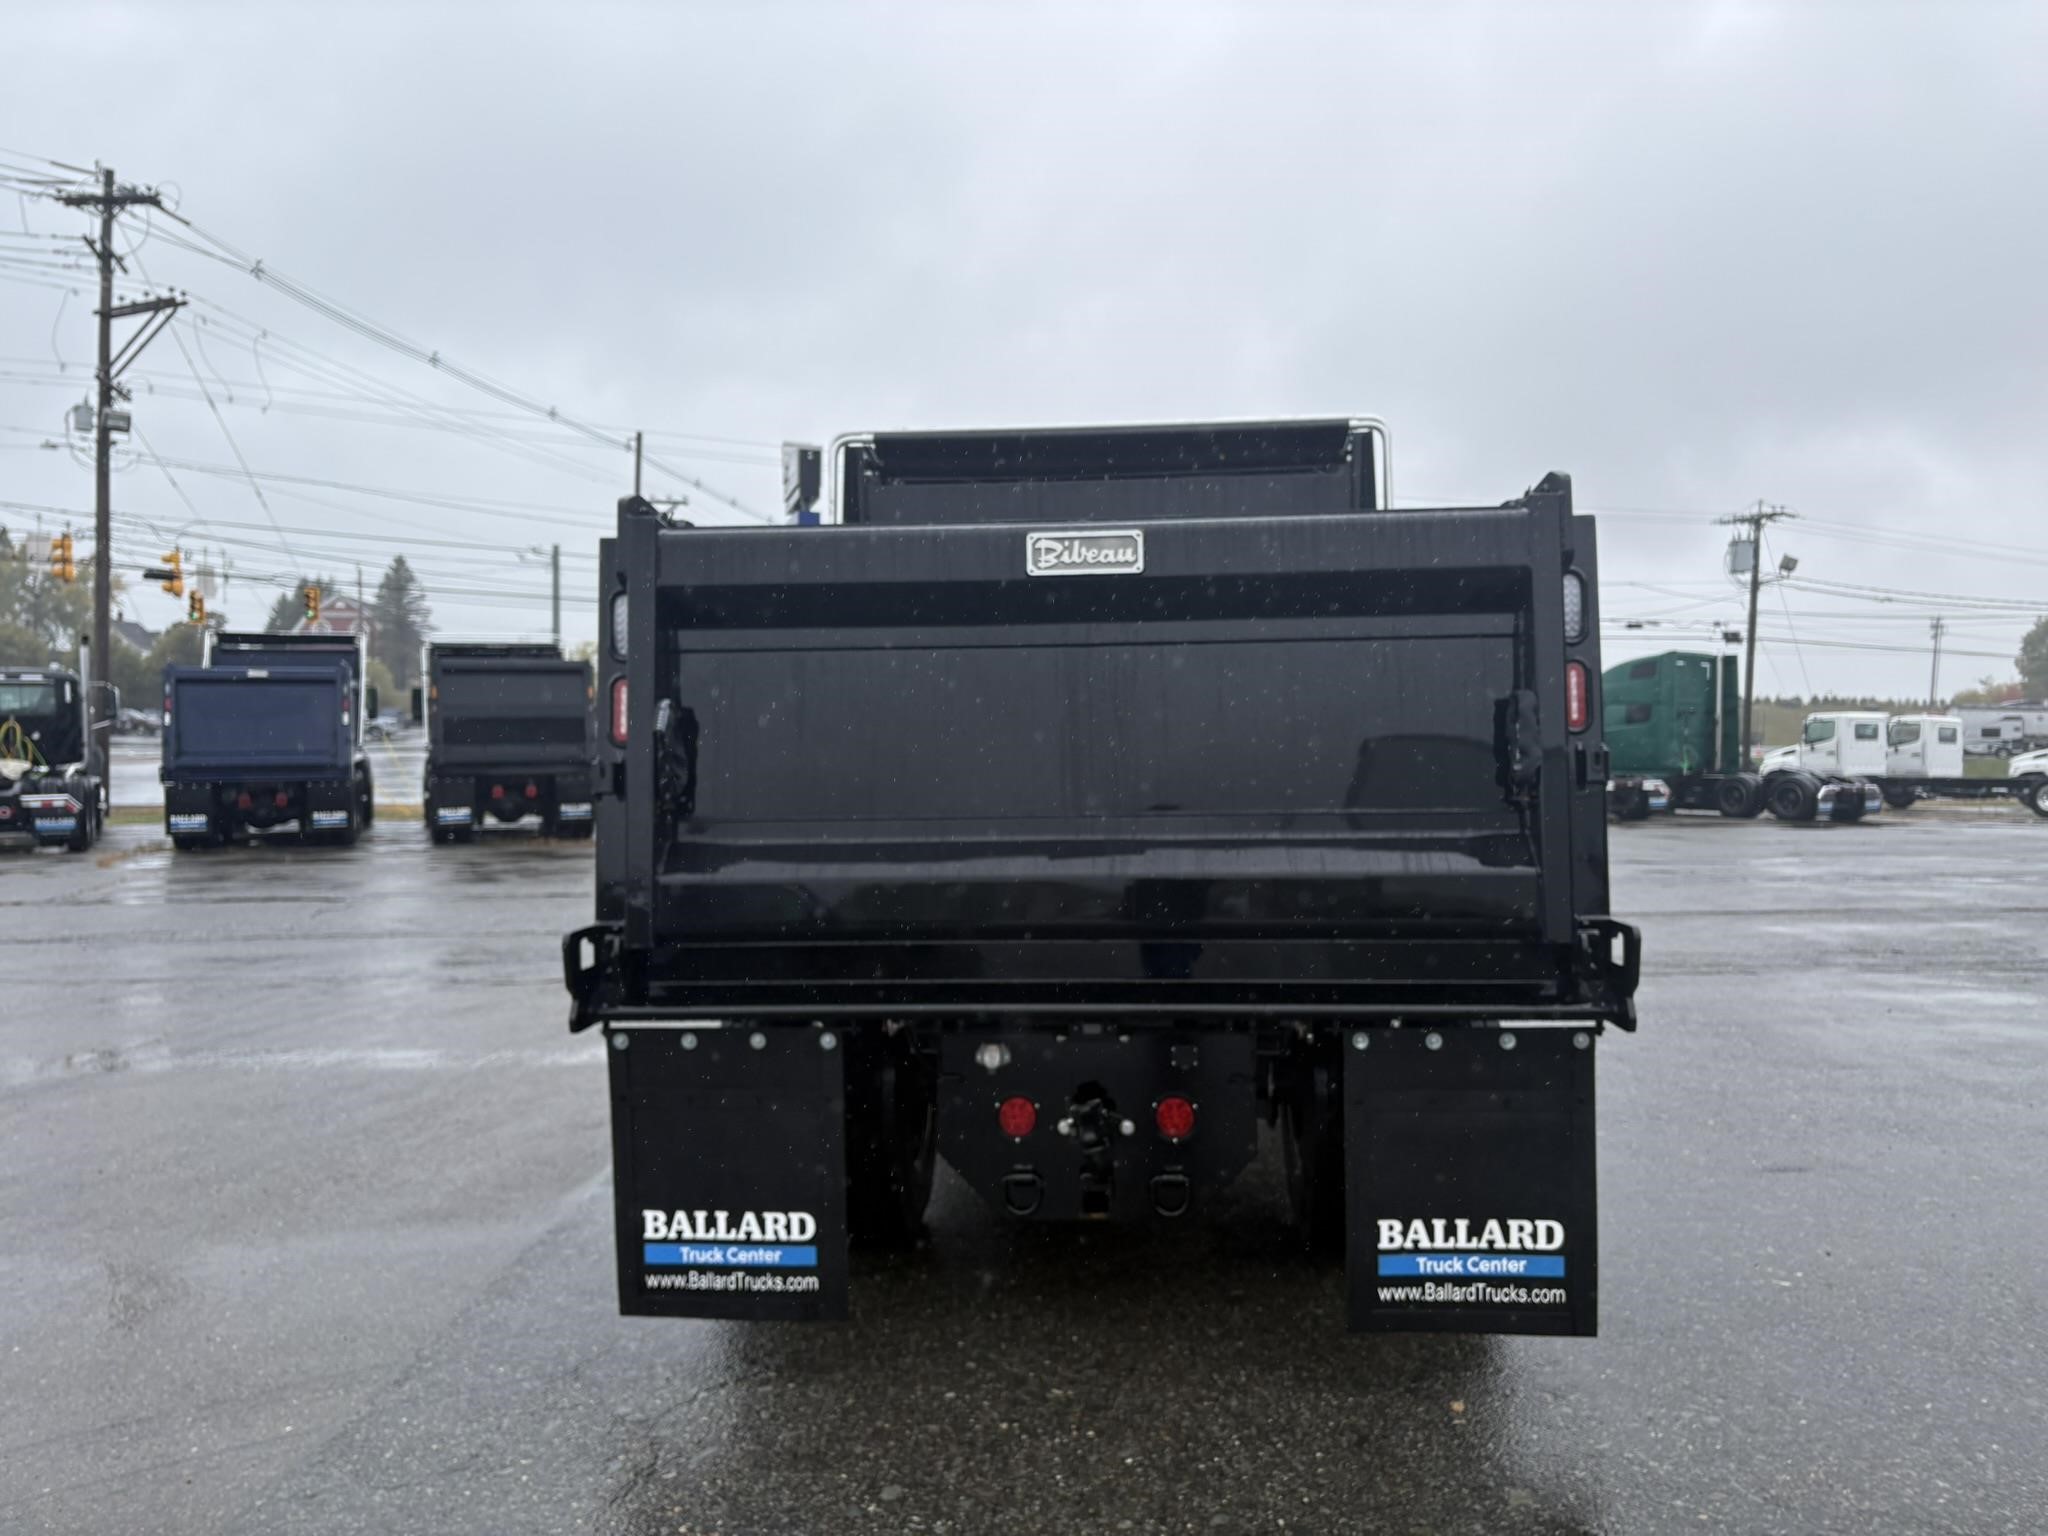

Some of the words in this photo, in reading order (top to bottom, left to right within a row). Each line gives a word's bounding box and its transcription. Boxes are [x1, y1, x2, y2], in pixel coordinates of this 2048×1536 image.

[1034, 538, 1137, 569] Bibeau
[642, 1209, 817, 1241] BALLARD
[1377, 1218, 1565, 1250] BALLARD
[679, 1246, 724, 1264] Truck
[726, 1247, 783, 1263] Center
[1416, 1257, 1464, 1274] Truck
[1466, 1257, 1528, 1274] Center
[645, 1270, 820, 1292] www.BallardTrucks.com
[1377, 1282, 1567, 1304] www.BallardTrucks.com
